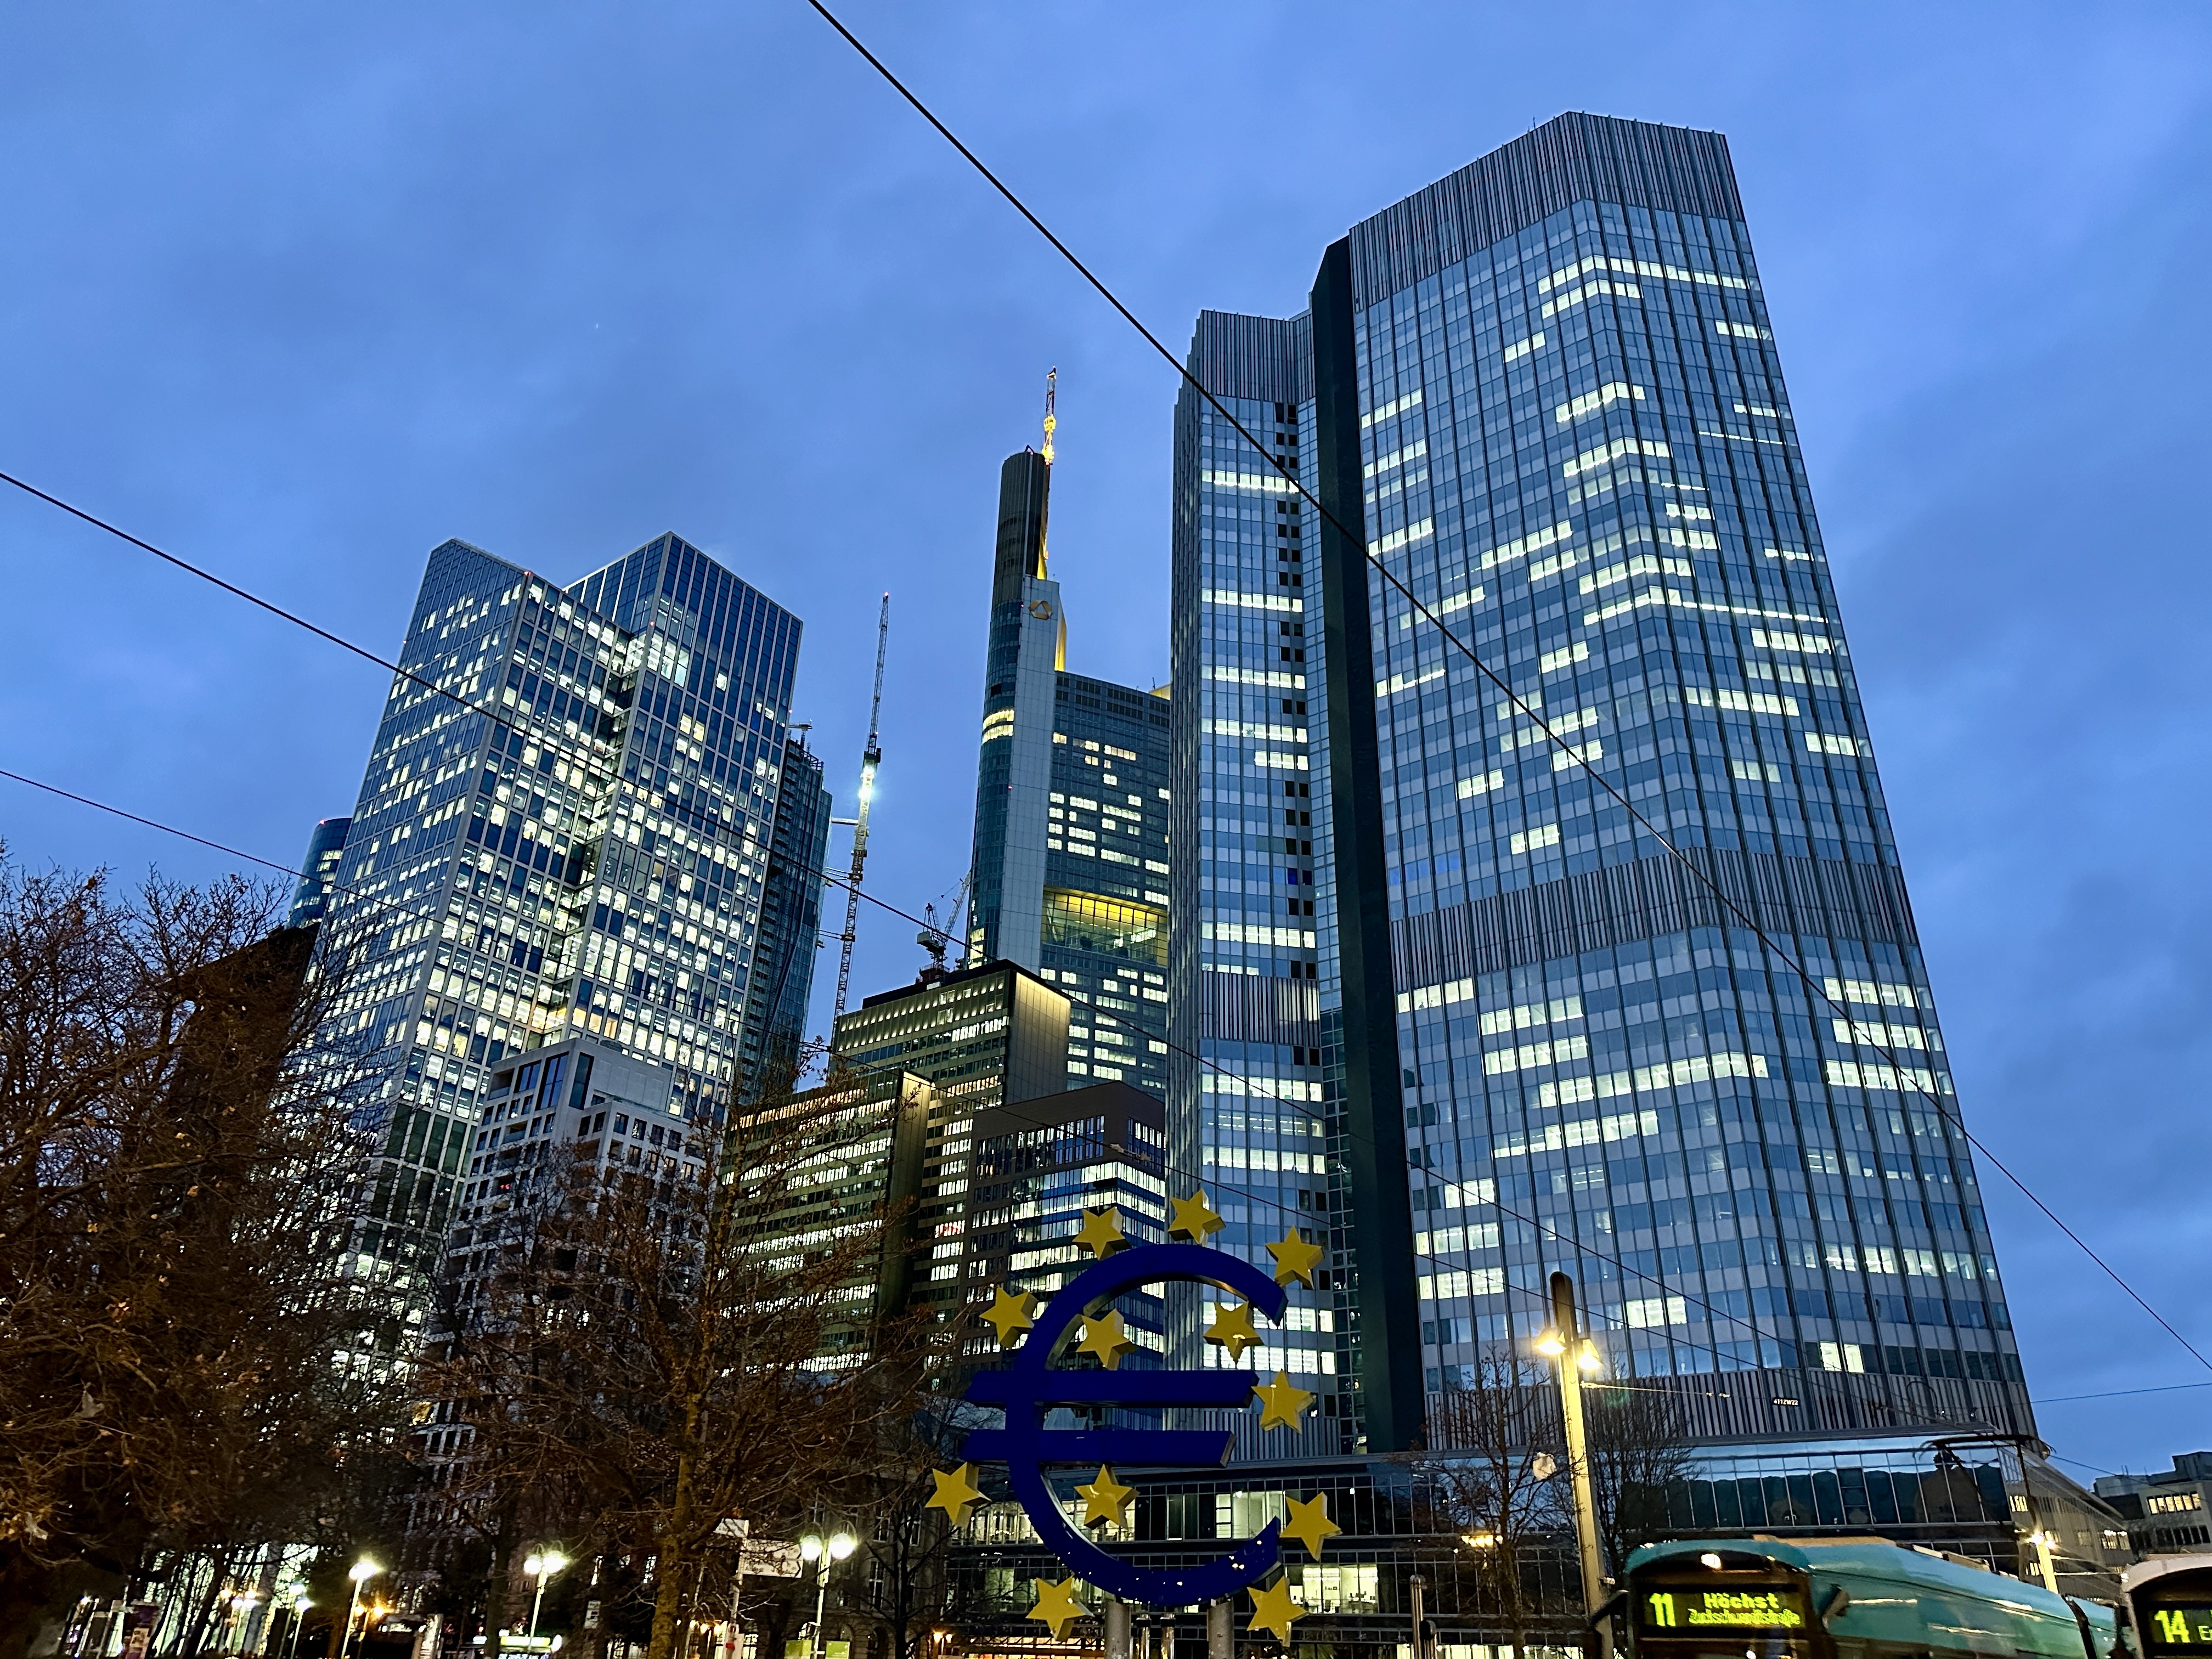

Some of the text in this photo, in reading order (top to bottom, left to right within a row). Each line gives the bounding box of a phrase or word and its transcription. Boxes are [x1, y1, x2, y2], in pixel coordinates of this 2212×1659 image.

[1649, 1593, 1779, 1627] 11 Höchst
[2154, 1610, 2191, 1643] 14
